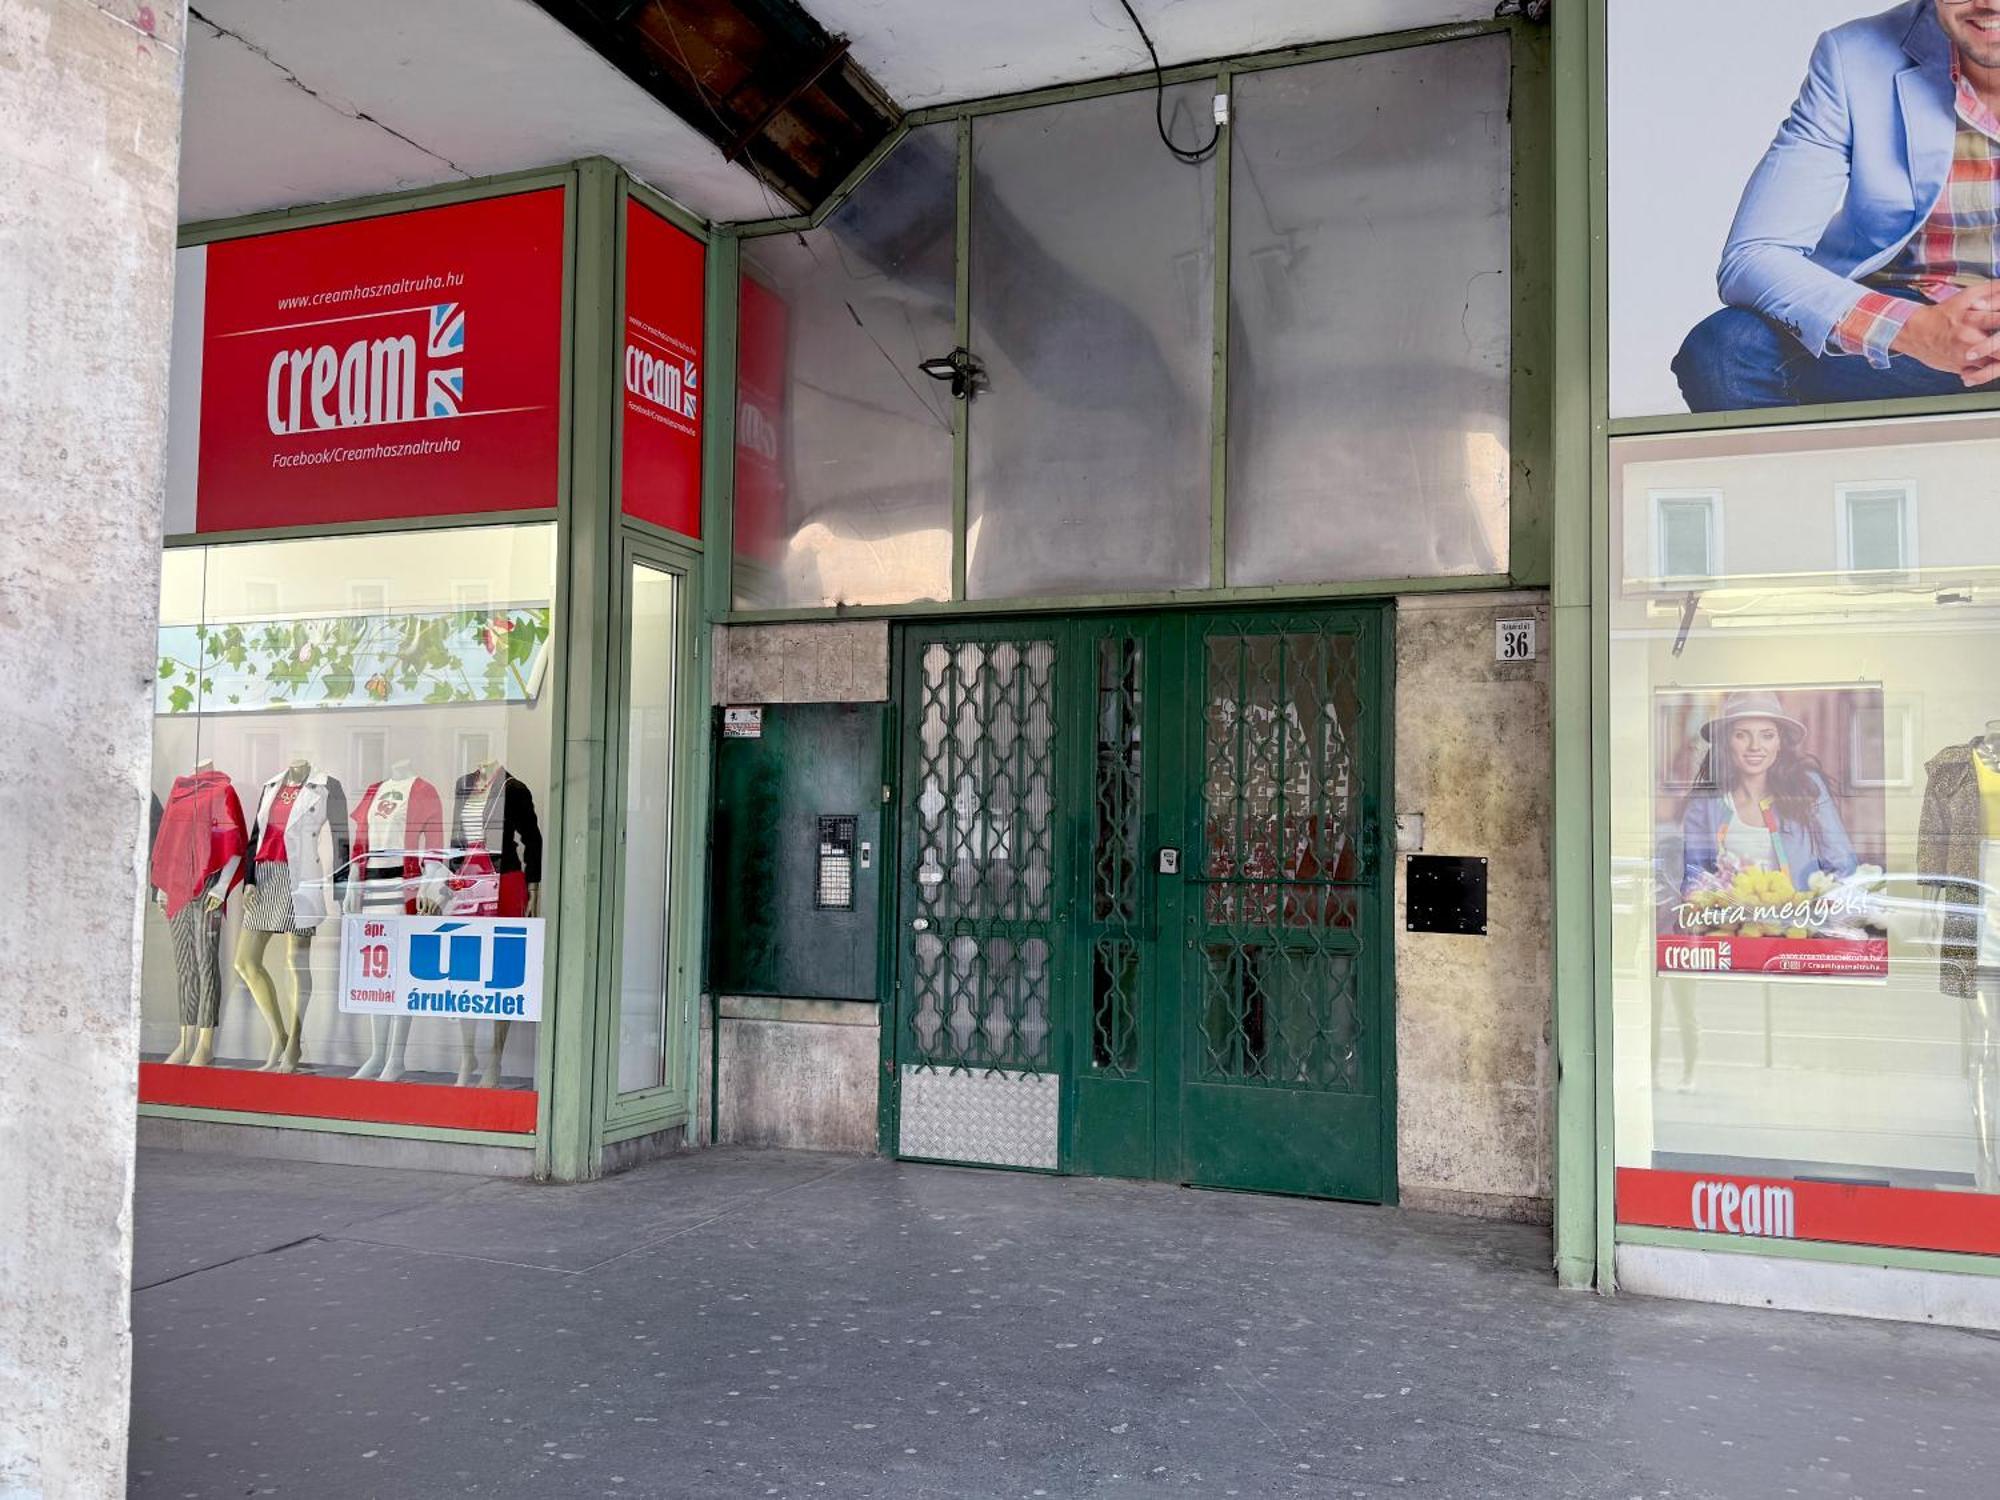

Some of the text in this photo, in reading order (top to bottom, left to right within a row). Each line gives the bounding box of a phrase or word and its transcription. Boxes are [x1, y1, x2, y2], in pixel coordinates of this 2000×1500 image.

[278, 272, 464, 310] www.creamhasznaltruha.hu
[267, 335, 416, 436] cream
[625, 344, 681, 413] cream
[272, 437, 461, 468] Facebook/Creamhasznaltruha
[1504, 631, 1529, 658] 36
[364, 920, 387, 938] ápr.
[359, 943, 392, 979] 19.
[408, 922, 528, 989] új
[1664, 944, 1716, 970] cream
[350, 987, 396, 1004] szombat
[407, 987, 525, 1015] árukészlet
[1691, 1179, 1795, 1238] cream
